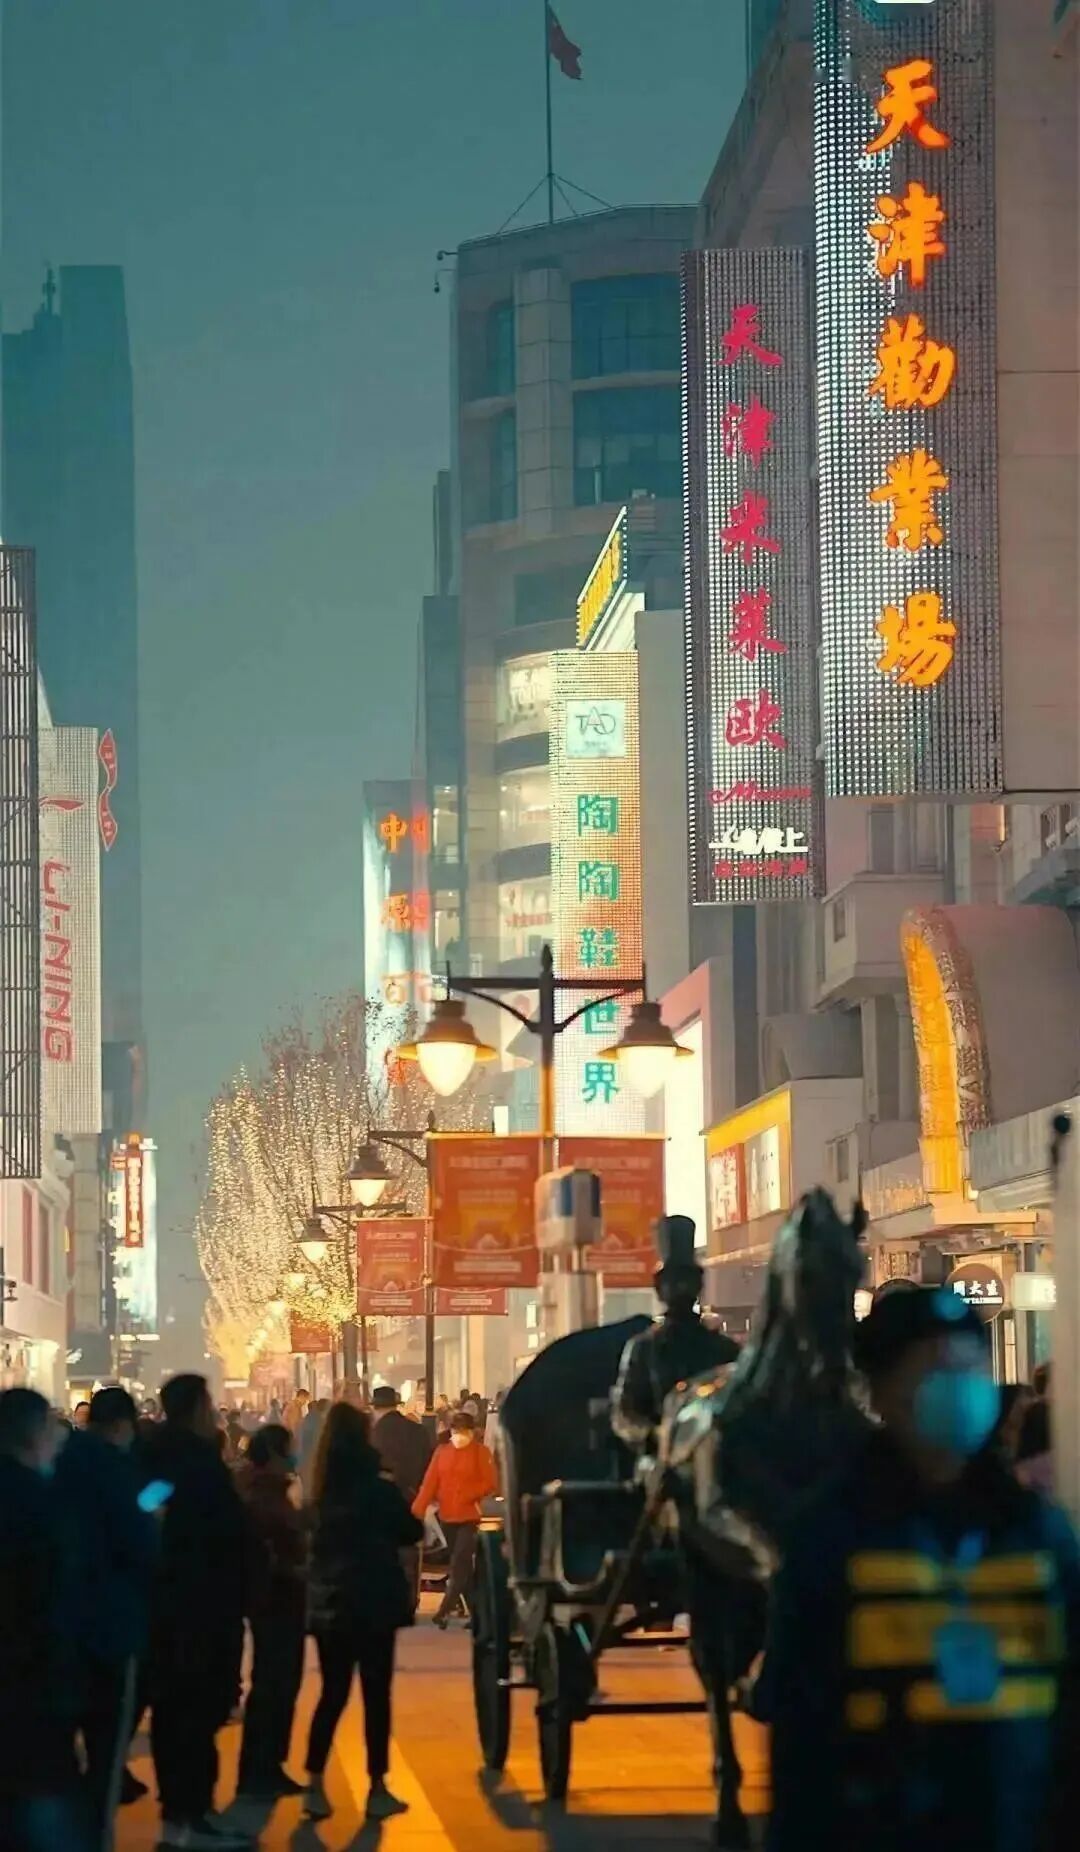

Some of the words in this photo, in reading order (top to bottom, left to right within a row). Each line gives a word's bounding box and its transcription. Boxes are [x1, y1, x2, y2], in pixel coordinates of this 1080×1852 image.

[865, 58, 958, 688] 天津勸業場
[43, 861, 73, 1064] LI-NING
[575, 794, 620, 1104] 陶陶鞋世界
